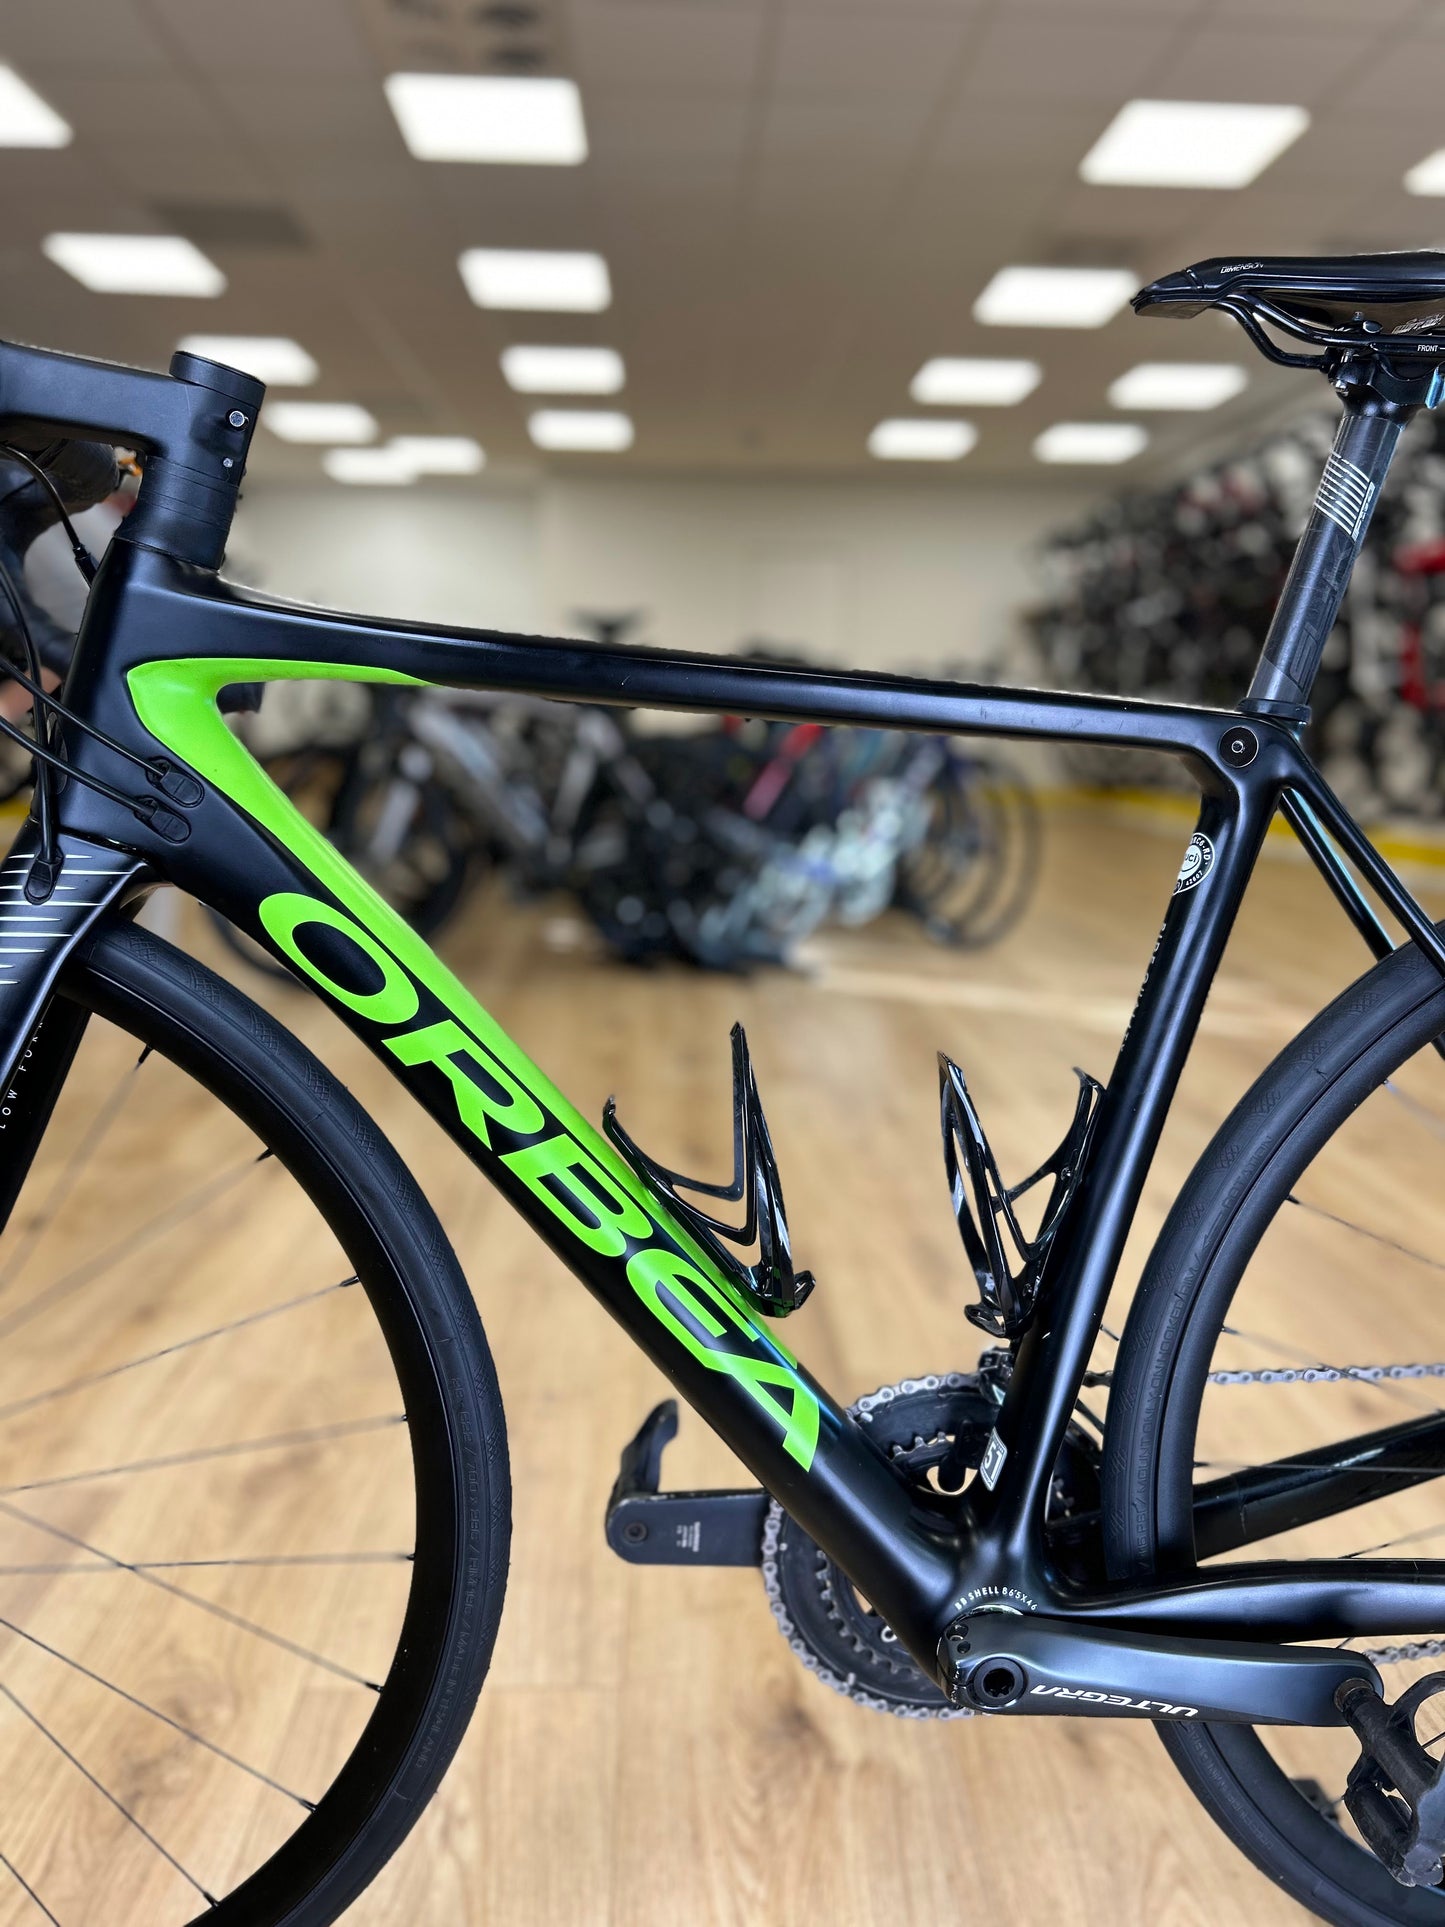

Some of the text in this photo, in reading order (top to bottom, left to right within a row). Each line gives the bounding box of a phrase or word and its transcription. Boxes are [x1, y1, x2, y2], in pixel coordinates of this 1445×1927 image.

[1417, 344, 1439, 352] FRONT
[259, 893, 820, 1472] ORBEA
[954, 1597, 968, 1610] BB
[968, 1585, 1000, 1601] SHELL
[1030, 1684, 1199, 1717] ULTEGRA
